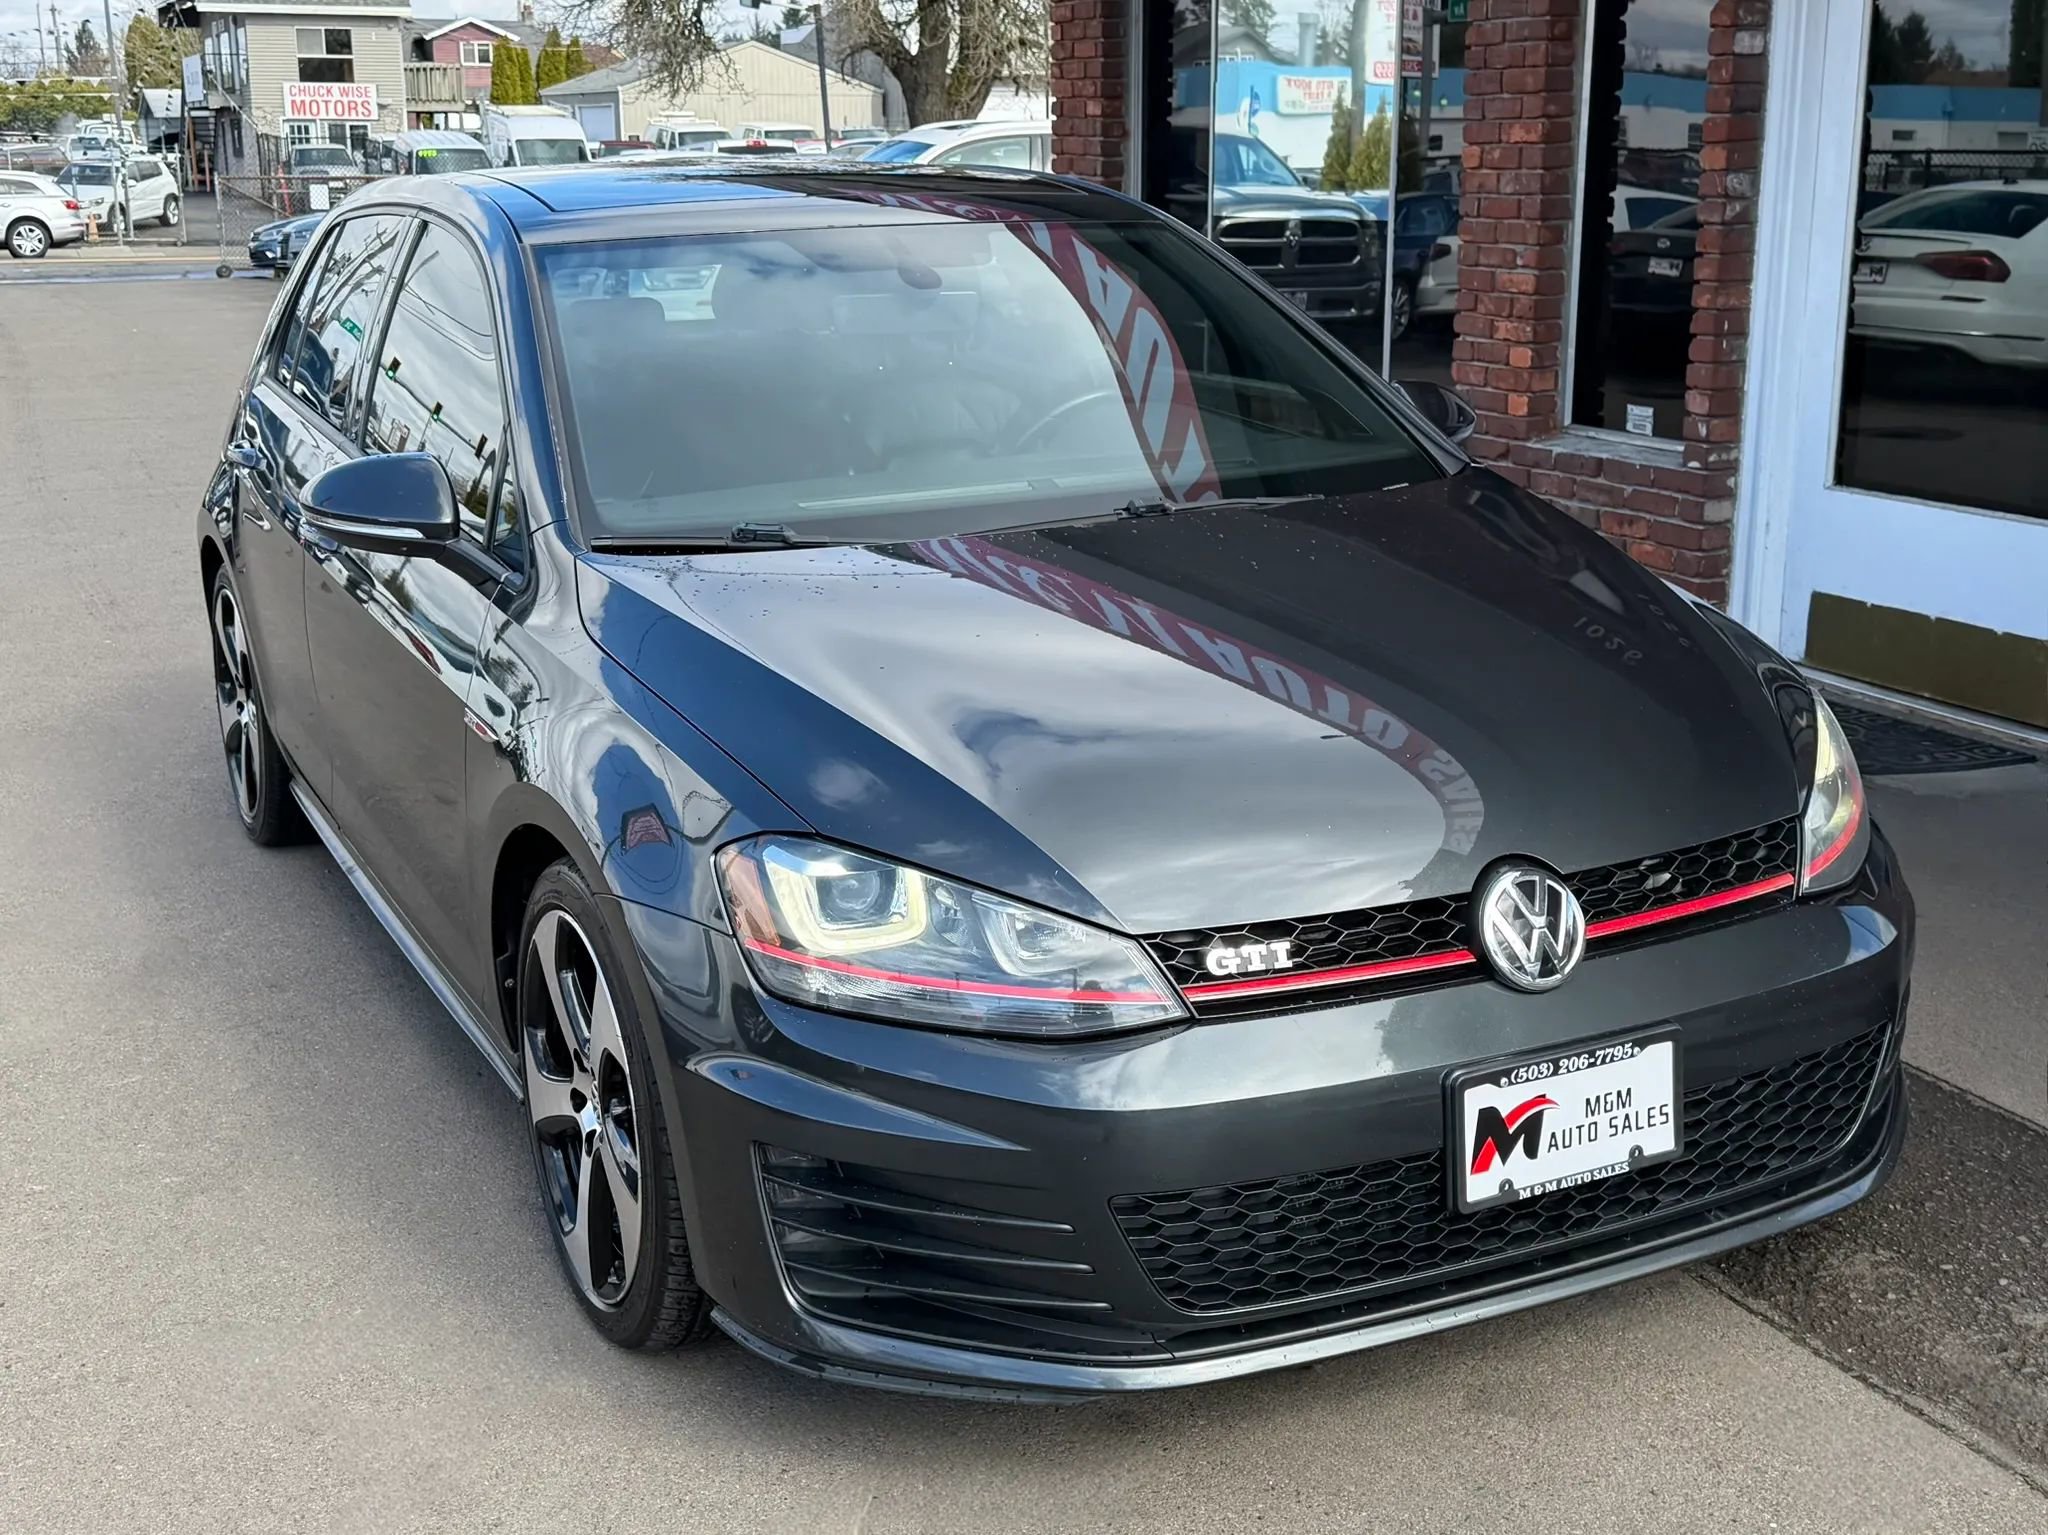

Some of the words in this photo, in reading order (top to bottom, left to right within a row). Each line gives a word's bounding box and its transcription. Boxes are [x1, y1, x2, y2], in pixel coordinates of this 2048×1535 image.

[289, 84, 335, 98] CHUCK
[338, 85, 372, 98] WISE
[290, 99, 372, 117] MOTORS
[1205, 941, 1294, 977] GTI
[1510, 1063, 1554, 1084] (503)
[1558, 1042, 1633, 1074] 206-7795
[1585, 1087, 1632, 1118] M&M
[1547, 1121, 1598, 1154] AUTO
[1608, 1103, 1669, 1138] SALES
[1559, 1172, 1592, 1189] AUTO
[1592, 1161, 1630, 1182] SALES
